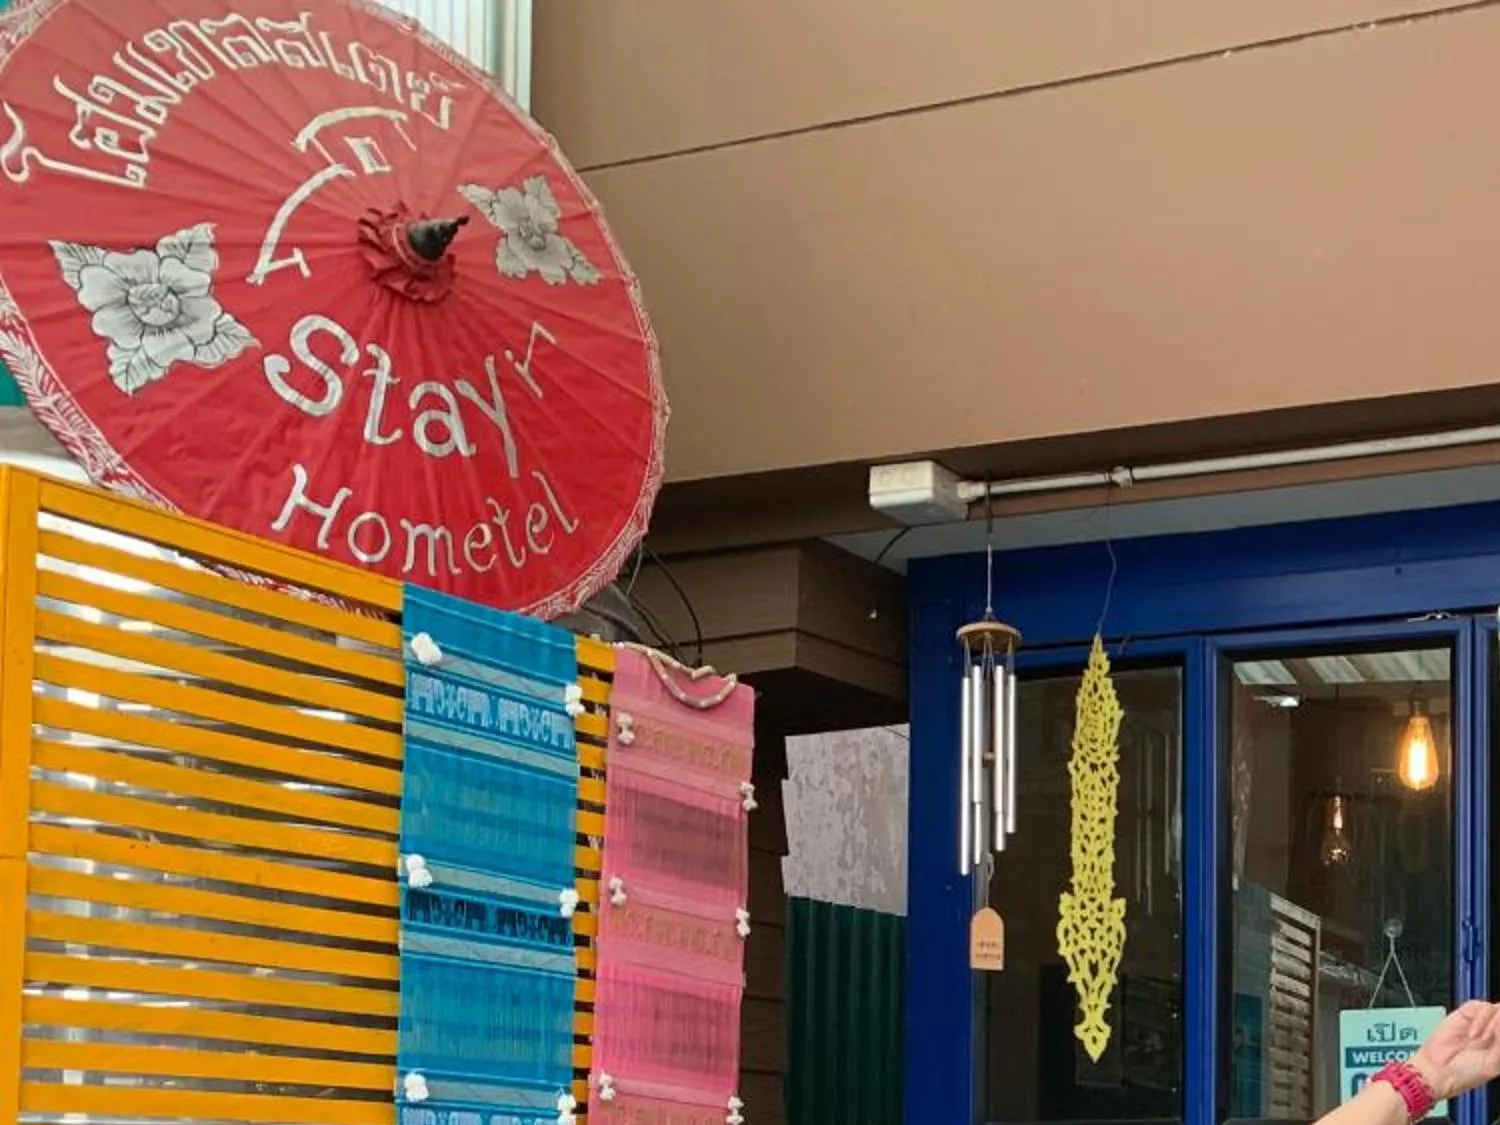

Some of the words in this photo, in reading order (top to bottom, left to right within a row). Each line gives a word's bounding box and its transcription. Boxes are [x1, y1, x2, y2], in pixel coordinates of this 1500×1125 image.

[263, 315, 519, 479] Stay
[271, 463, 579, 573] Hometel
[1351, 1050, 1415, 1064] WELCO
[1367, 1021, 1418, 1041] เปิด
